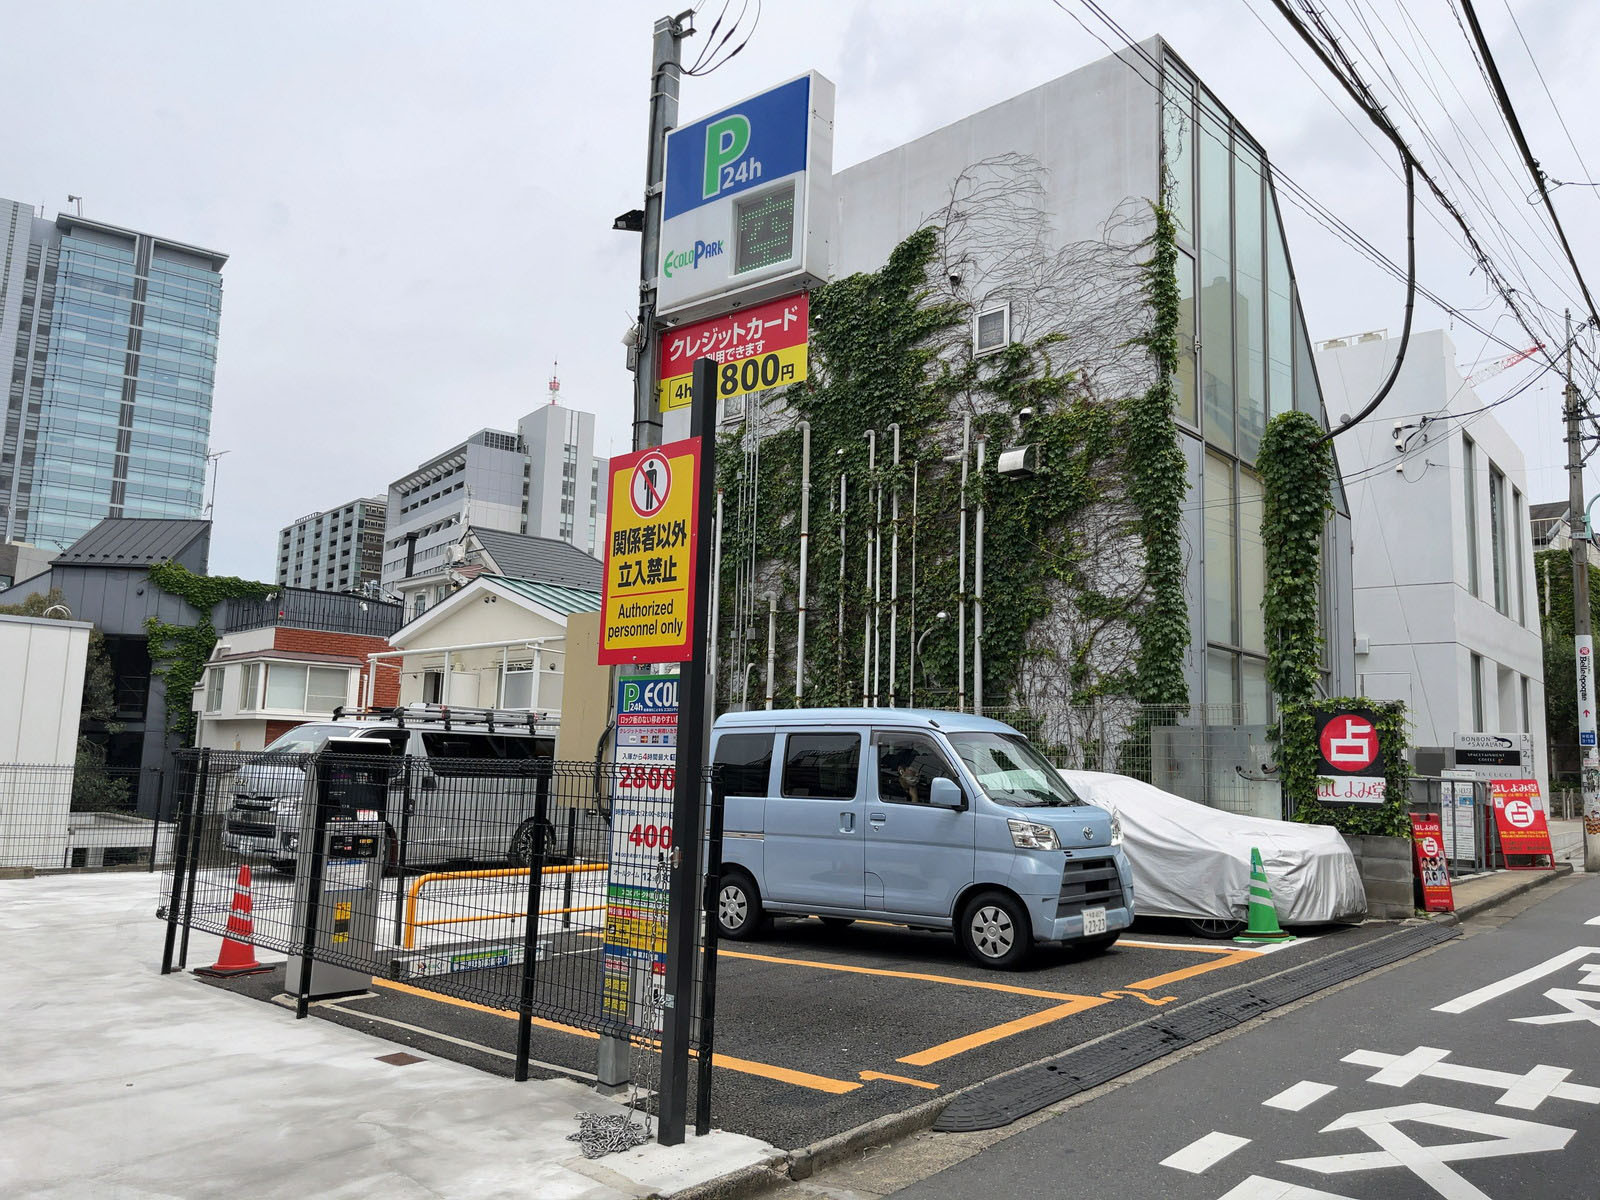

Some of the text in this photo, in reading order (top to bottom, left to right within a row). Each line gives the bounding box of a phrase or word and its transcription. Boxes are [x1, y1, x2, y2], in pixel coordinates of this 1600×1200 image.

[703, 114, 750, 200] P
[722, 157, 762, 190] 24h
[670, 305, 798, 362] クレジットカード
[698, 340, 765, 364] 利用できます
[613, 519, 687, 557] 関係者以外
[618, 555, 677, 588] 立入禁止
[618, 599, 674, 619] Authorized
[608, 618, 683, 641] personnel only
[623, 683, 640, 712] P
[630, 703, 643, 711] 24h
[1330, 719, 1371, 762] 占
[619, 766, 676, 791] 2800
[1317, 780, 1386, 800] はしよみ堂
[1492, 783, 1537, 793] はしよみ堂
[1511, 802, 1529, 823] 占
[629, 824, 673, 850] 400
[1426, 839, 1436, 853] 占
[1088, 918, 1105, 933] 23-23
